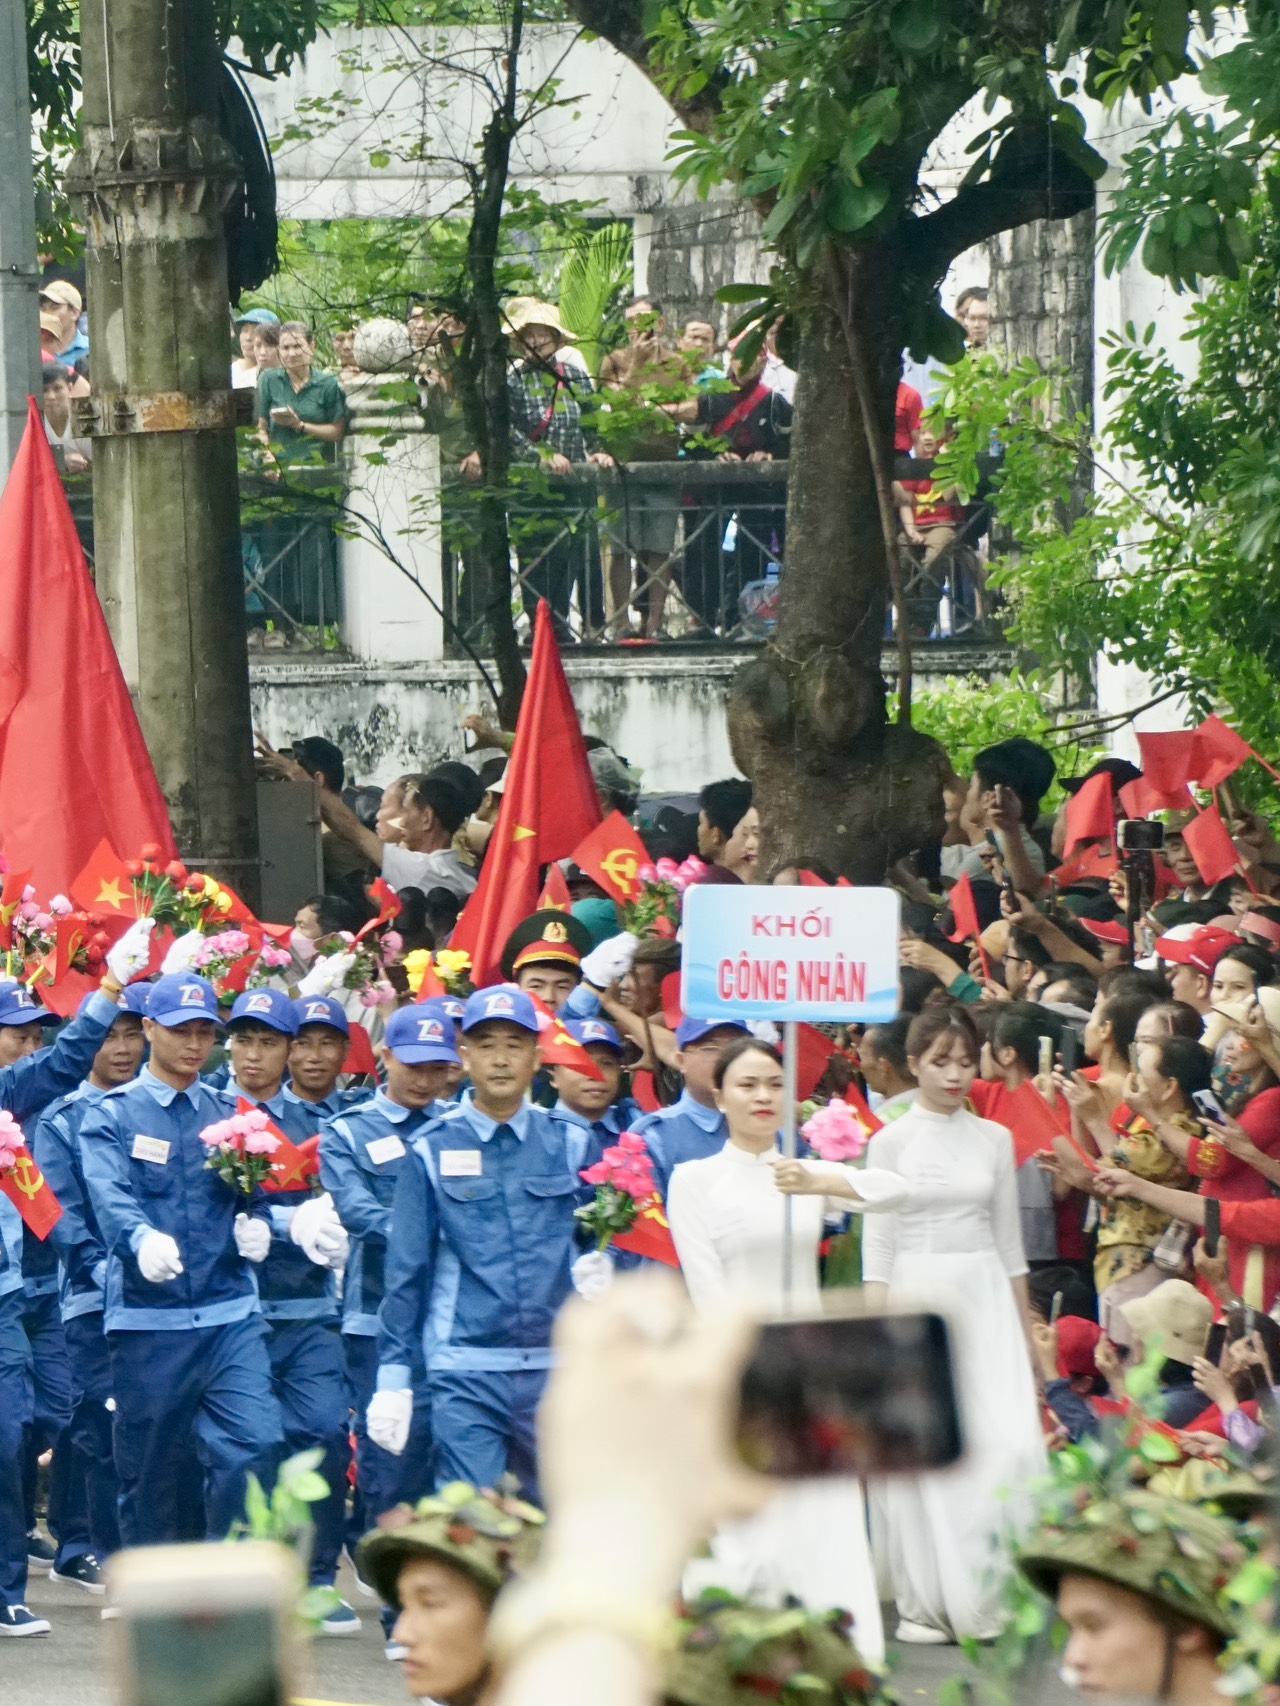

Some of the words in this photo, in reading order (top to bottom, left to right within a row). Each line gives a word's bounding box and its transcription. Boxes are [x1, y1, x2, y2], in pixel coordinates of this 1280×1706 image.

[751, 906, 833, 938] KHỐI
[718, 950, 788, 1001] CÔNG
[796, 951, 866, 1003] NHÂN
